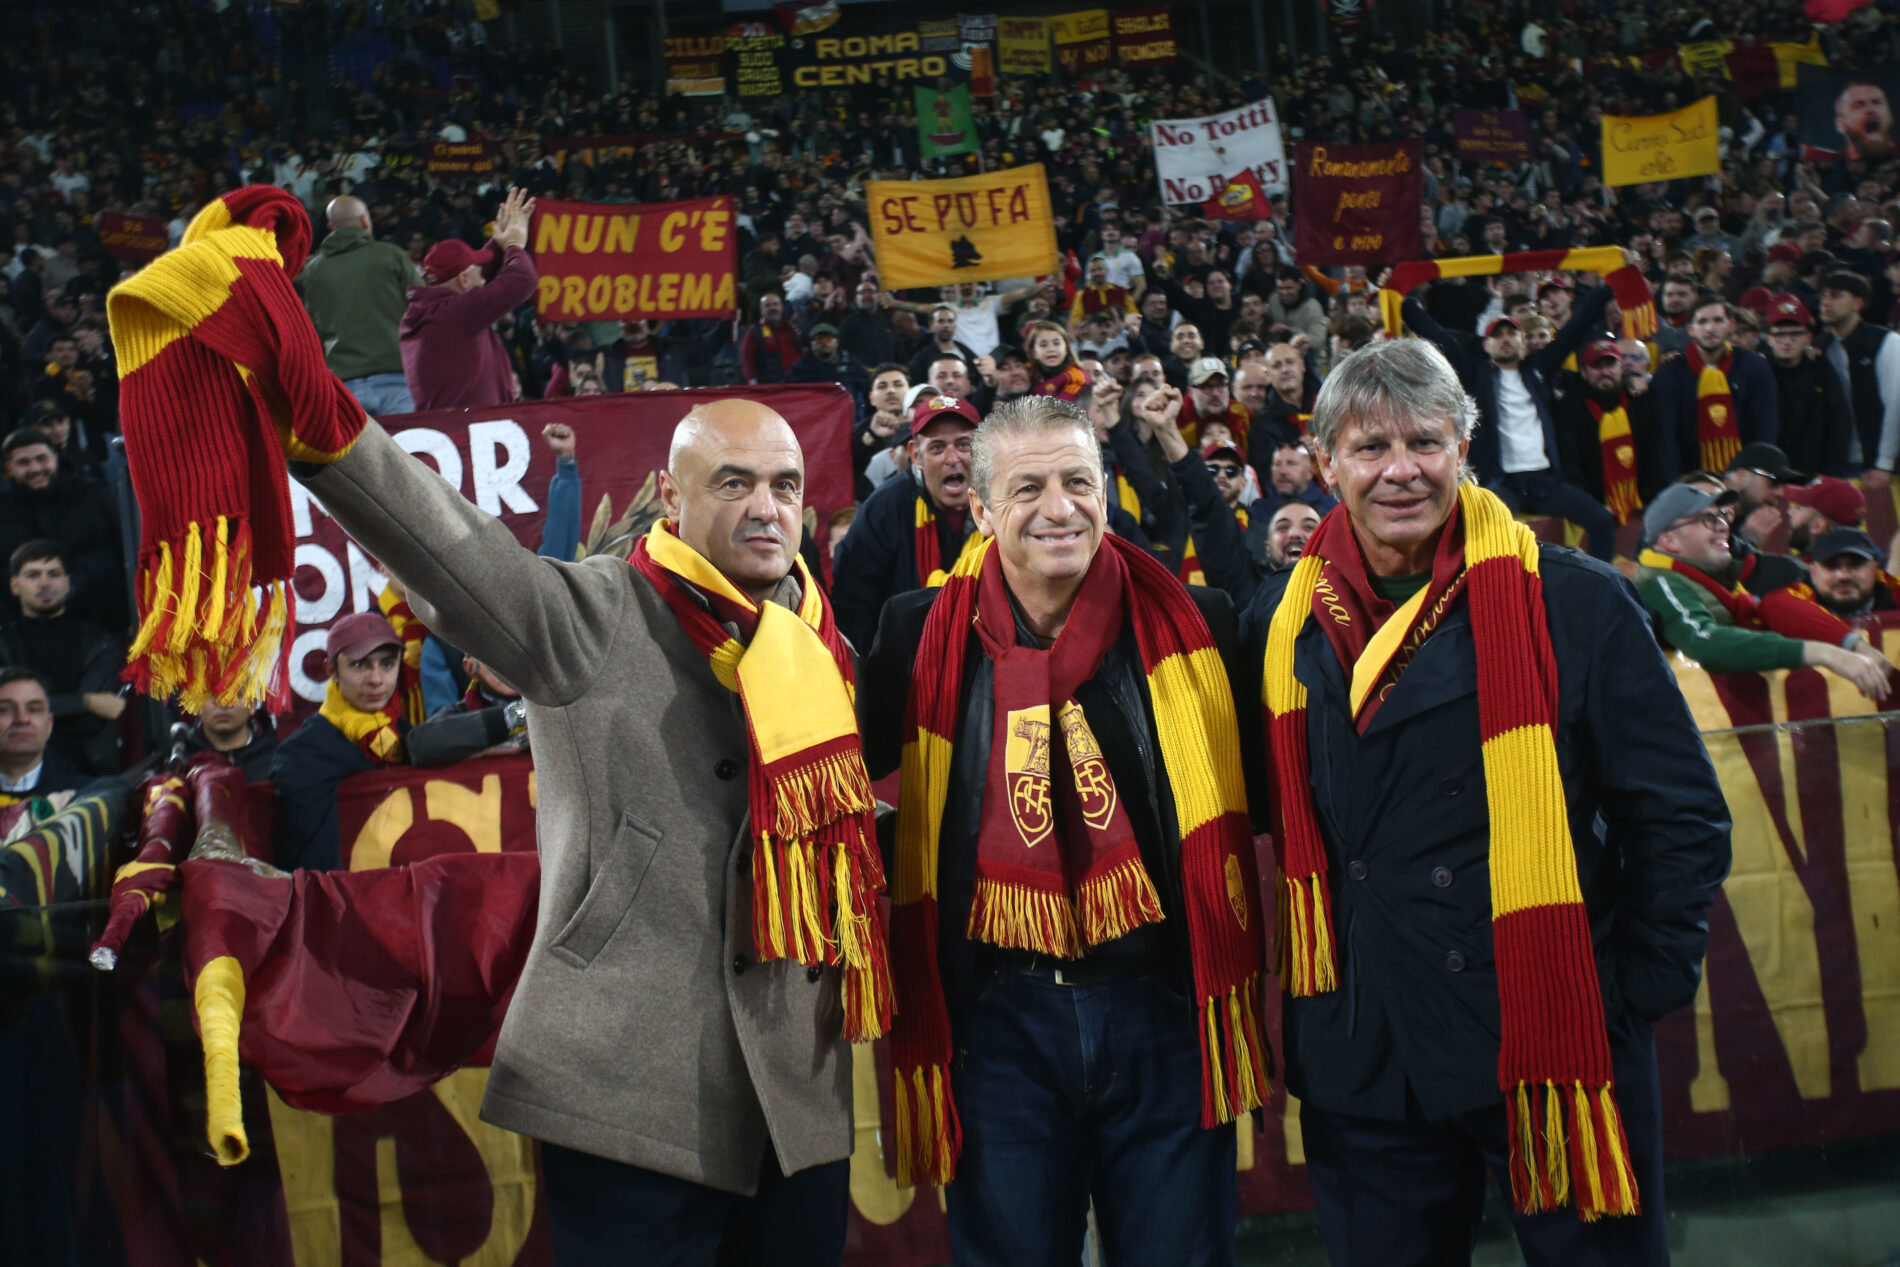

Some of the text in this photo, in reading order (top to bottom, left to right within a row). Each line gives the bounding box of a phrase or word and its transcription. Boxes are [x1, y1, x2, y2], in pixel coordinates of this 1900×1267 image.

[816, 31, 920, 60] ROMA
[793, 56, 947, 86] CENTRO
[1155, 101, 1271, 147] No Totti
[1163, 161, 1279, 203] No pty
[534, 213, 642, 254] NUN
[882, 196, 926, 235] SE
[537, 272, 736, 317] PROBLEMA
